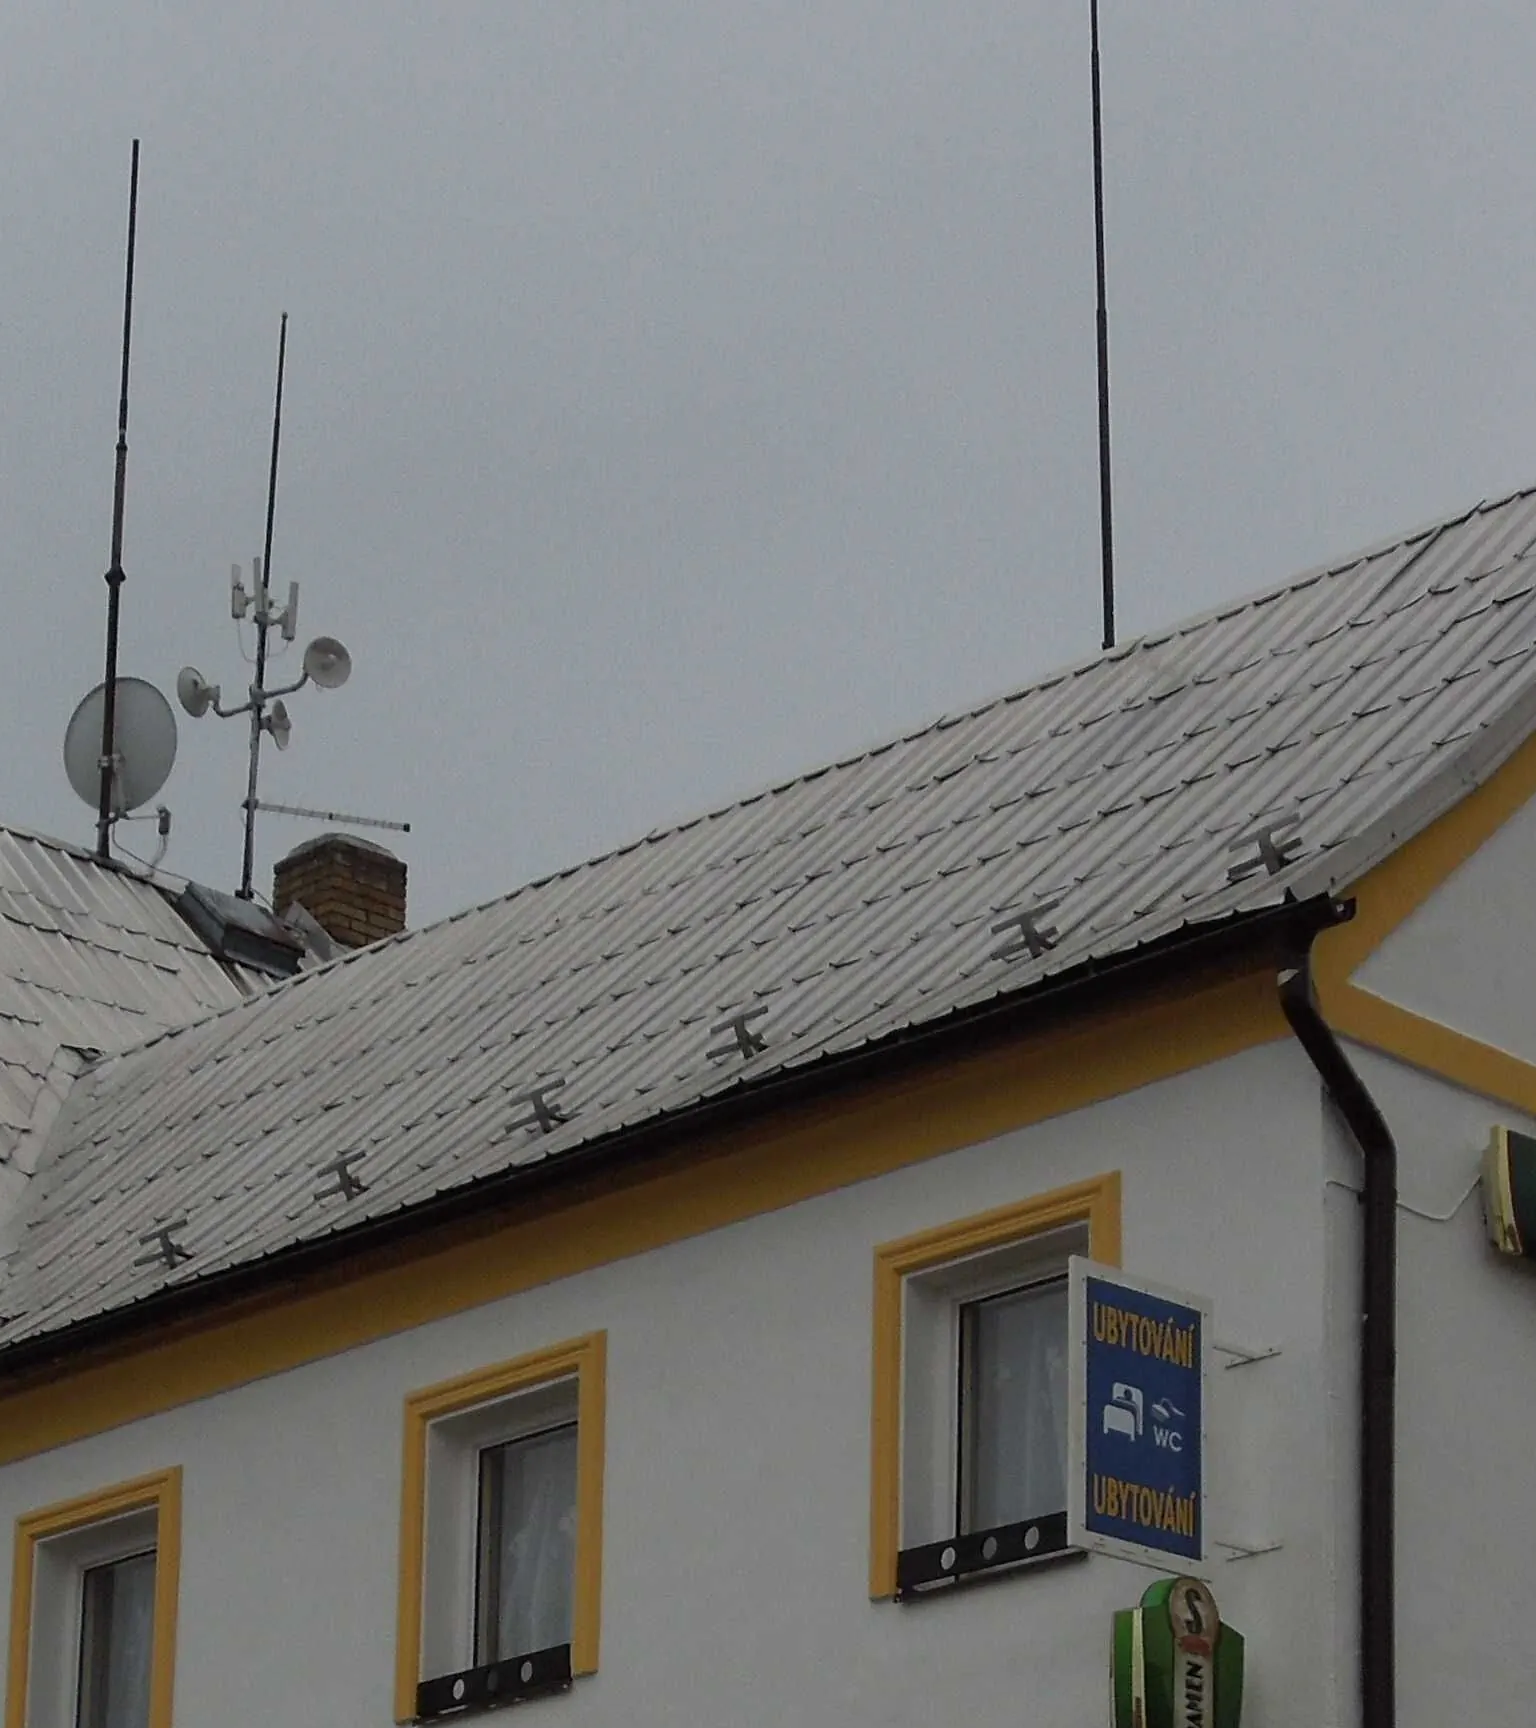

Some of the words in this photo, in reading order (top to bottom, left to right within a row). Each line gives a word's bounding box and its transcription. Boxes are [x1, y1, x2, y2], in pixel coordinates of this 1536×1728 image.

[1093, 1302, 1194, 1369] UBYTOVÁNÍ
[1153, 1425, 1184, 1452] WC
[1093, 1473, 1196, 1538] UBYTOVÁNÍ
